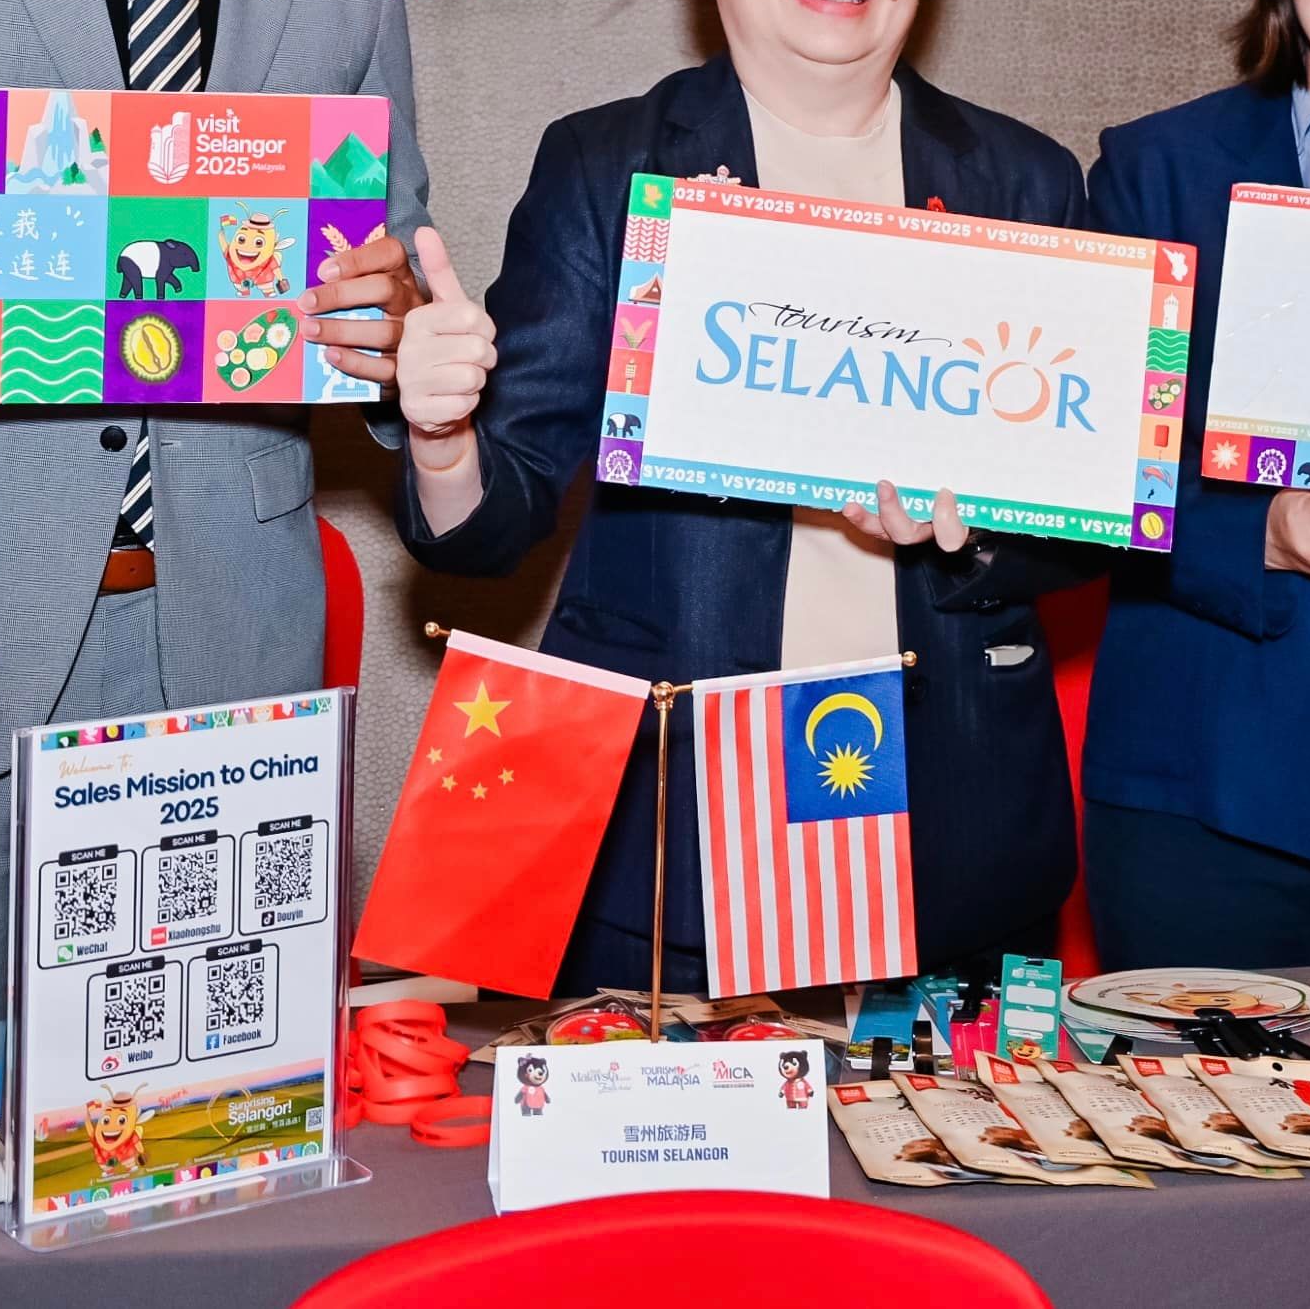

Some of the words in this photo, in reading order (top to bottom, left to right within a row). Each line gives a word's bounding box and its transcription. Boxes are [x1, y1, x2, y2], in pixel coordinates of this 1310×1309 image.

[196, 113, 240, 133] visit
[195, 134, 287, 158] Selangor
[195, 156, 250, 175] 2025
[1236, 190, 1279, 202] VSY2025
[721, 193, 794, 215] VSY2025
[810, 204, 884, 227] VSY2025
[898, 216, 972, 238] VSY2025
[986, 227, 1060, 250] VSY2025
[1074, 238, 1148, 262] VSY2025
[695, 300, 1097, 433] SELANGOR
[643, 463, 706, 484] SY2025
[721, 473, 797, 496] VSY2025
[811, 485, 875, 506] VSY202
[901, 495, 976, 518] VSY25
[991, 507, 1066, 529] VSY2025
[1081, 518, 1131, 538] VSY20
[54, 782, 121, 809] Sales
[126, 768, 215, 799] Mission
[220, 764, 245, 785] to
[250, 754, 319, 782] China
[160, 796, 220, 825] 2025
[269, 821, 288, 832] SCAN
[172, 836, 191, 847] SCAN
[71, 850, 92, 861] SCAN
[93, 848, 106, 858] ME
[277, 909, 304, 923] Douyin
[168, 923, 221, 942] Xiaohongshu
[76, 942, 108, 957] WeChat
[217, 945, 236, 956] SCAN
[118, 962, 138, 973] SCAN
[223, 1028, 262, 1045] Facebook
[127, 1049, 154, 1064] Weibo
[641, 1066, 677, 1076] TOURISM
[715, 1067, 753, 1080] MICA
[647, 1074, 700, 1090] MALAYSIA
[229, 1096, 275, 1111] Surprising
[229, 1099, 292, 1125] Selangor!
[624, 1124, 707, 1143] 雪州旅游局
[601, 1150, 659, 1164] TOURISM
[663, 1147, 729, 1162] SELANGOR
